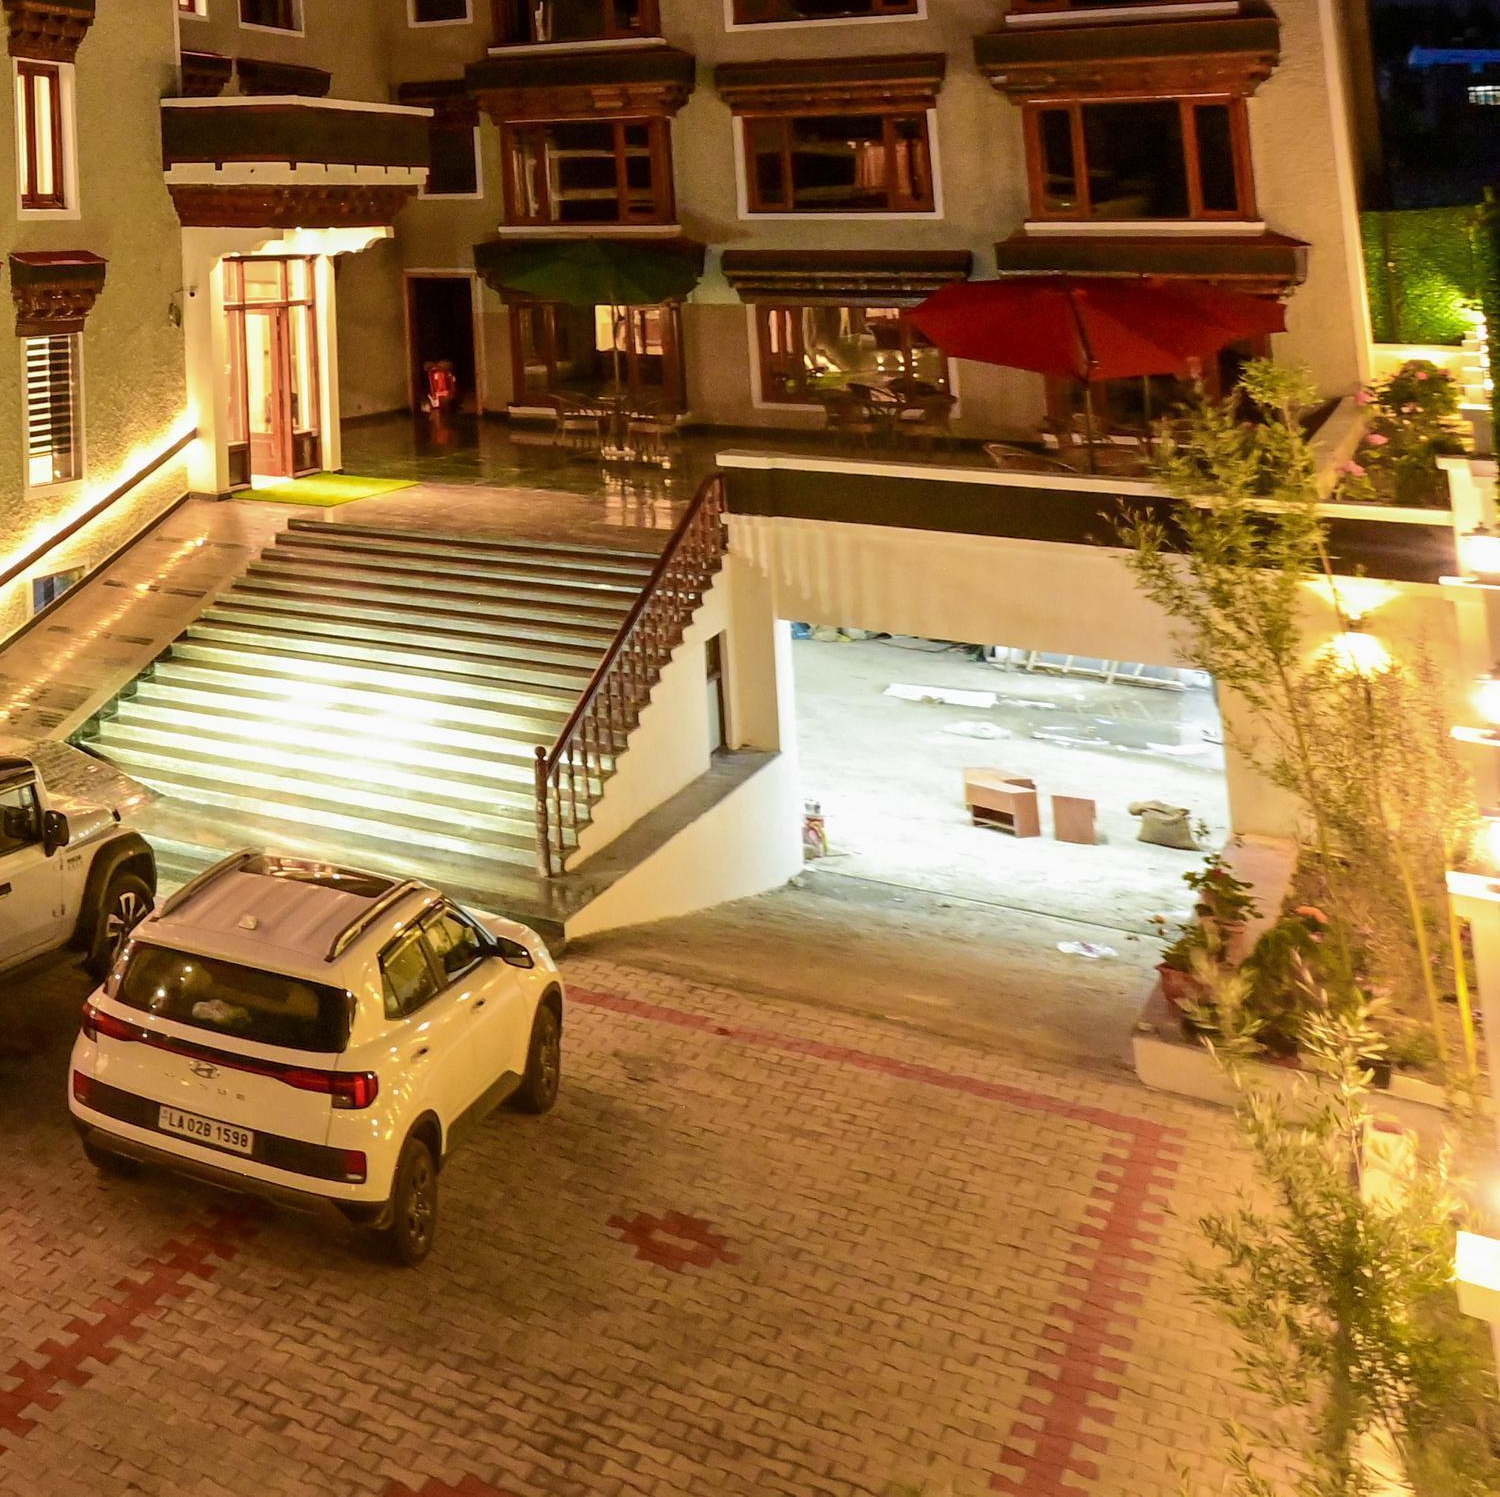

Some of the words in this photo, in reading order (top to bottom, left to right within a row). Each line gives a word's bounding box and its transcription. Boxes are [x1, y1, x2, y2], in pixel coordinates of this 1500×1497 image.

[168, 1111, 185, 1130] LA
[187, 1118, 211, 1137] 02B
[216, 1126, 249, 1148] 1598
